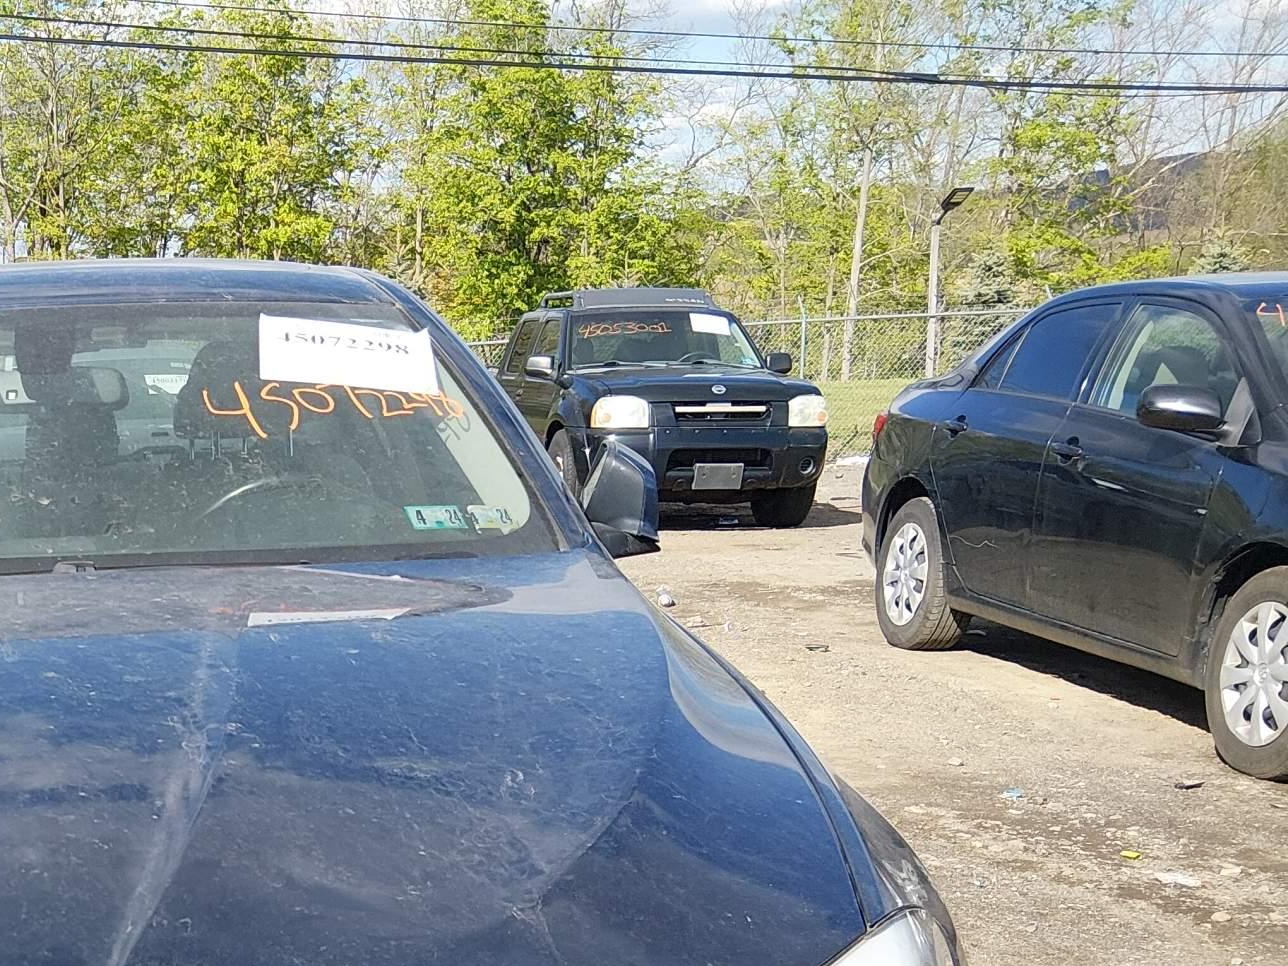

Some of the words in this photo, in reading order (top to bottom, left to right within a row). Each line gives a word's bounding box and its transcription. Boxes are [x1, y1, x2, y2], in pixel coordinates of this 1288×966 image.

[415, 510, 427, 525] 4
[444, 509, 462, 524] 24
[495, 508, 513, 524] 24
